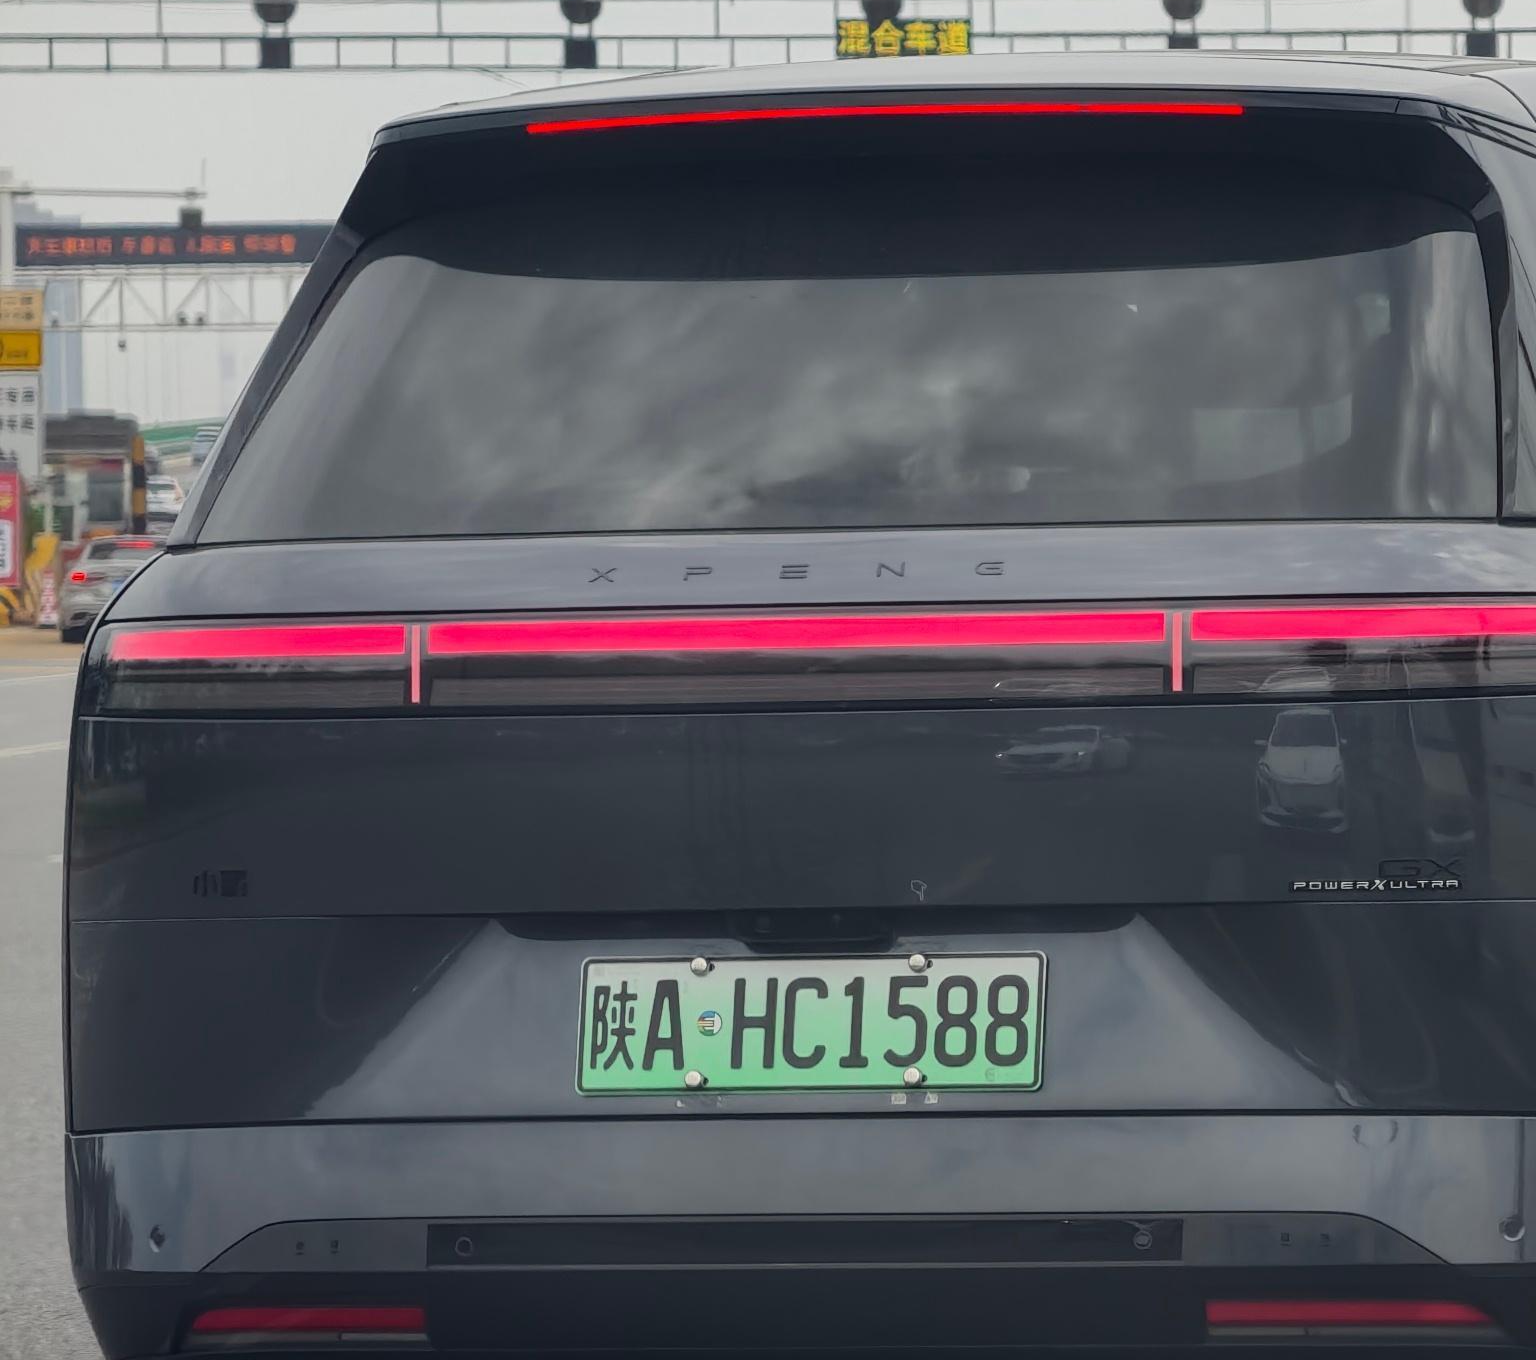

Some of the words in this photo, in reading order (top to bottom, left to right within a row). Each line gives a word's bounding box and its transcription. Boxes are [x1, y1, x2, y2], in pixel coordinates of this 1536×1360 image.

[838, 19, 969, 56] 混合车道
[588, 560, 1006, 584] XPENG
[730, 973, 1030, 1070] HC1588
